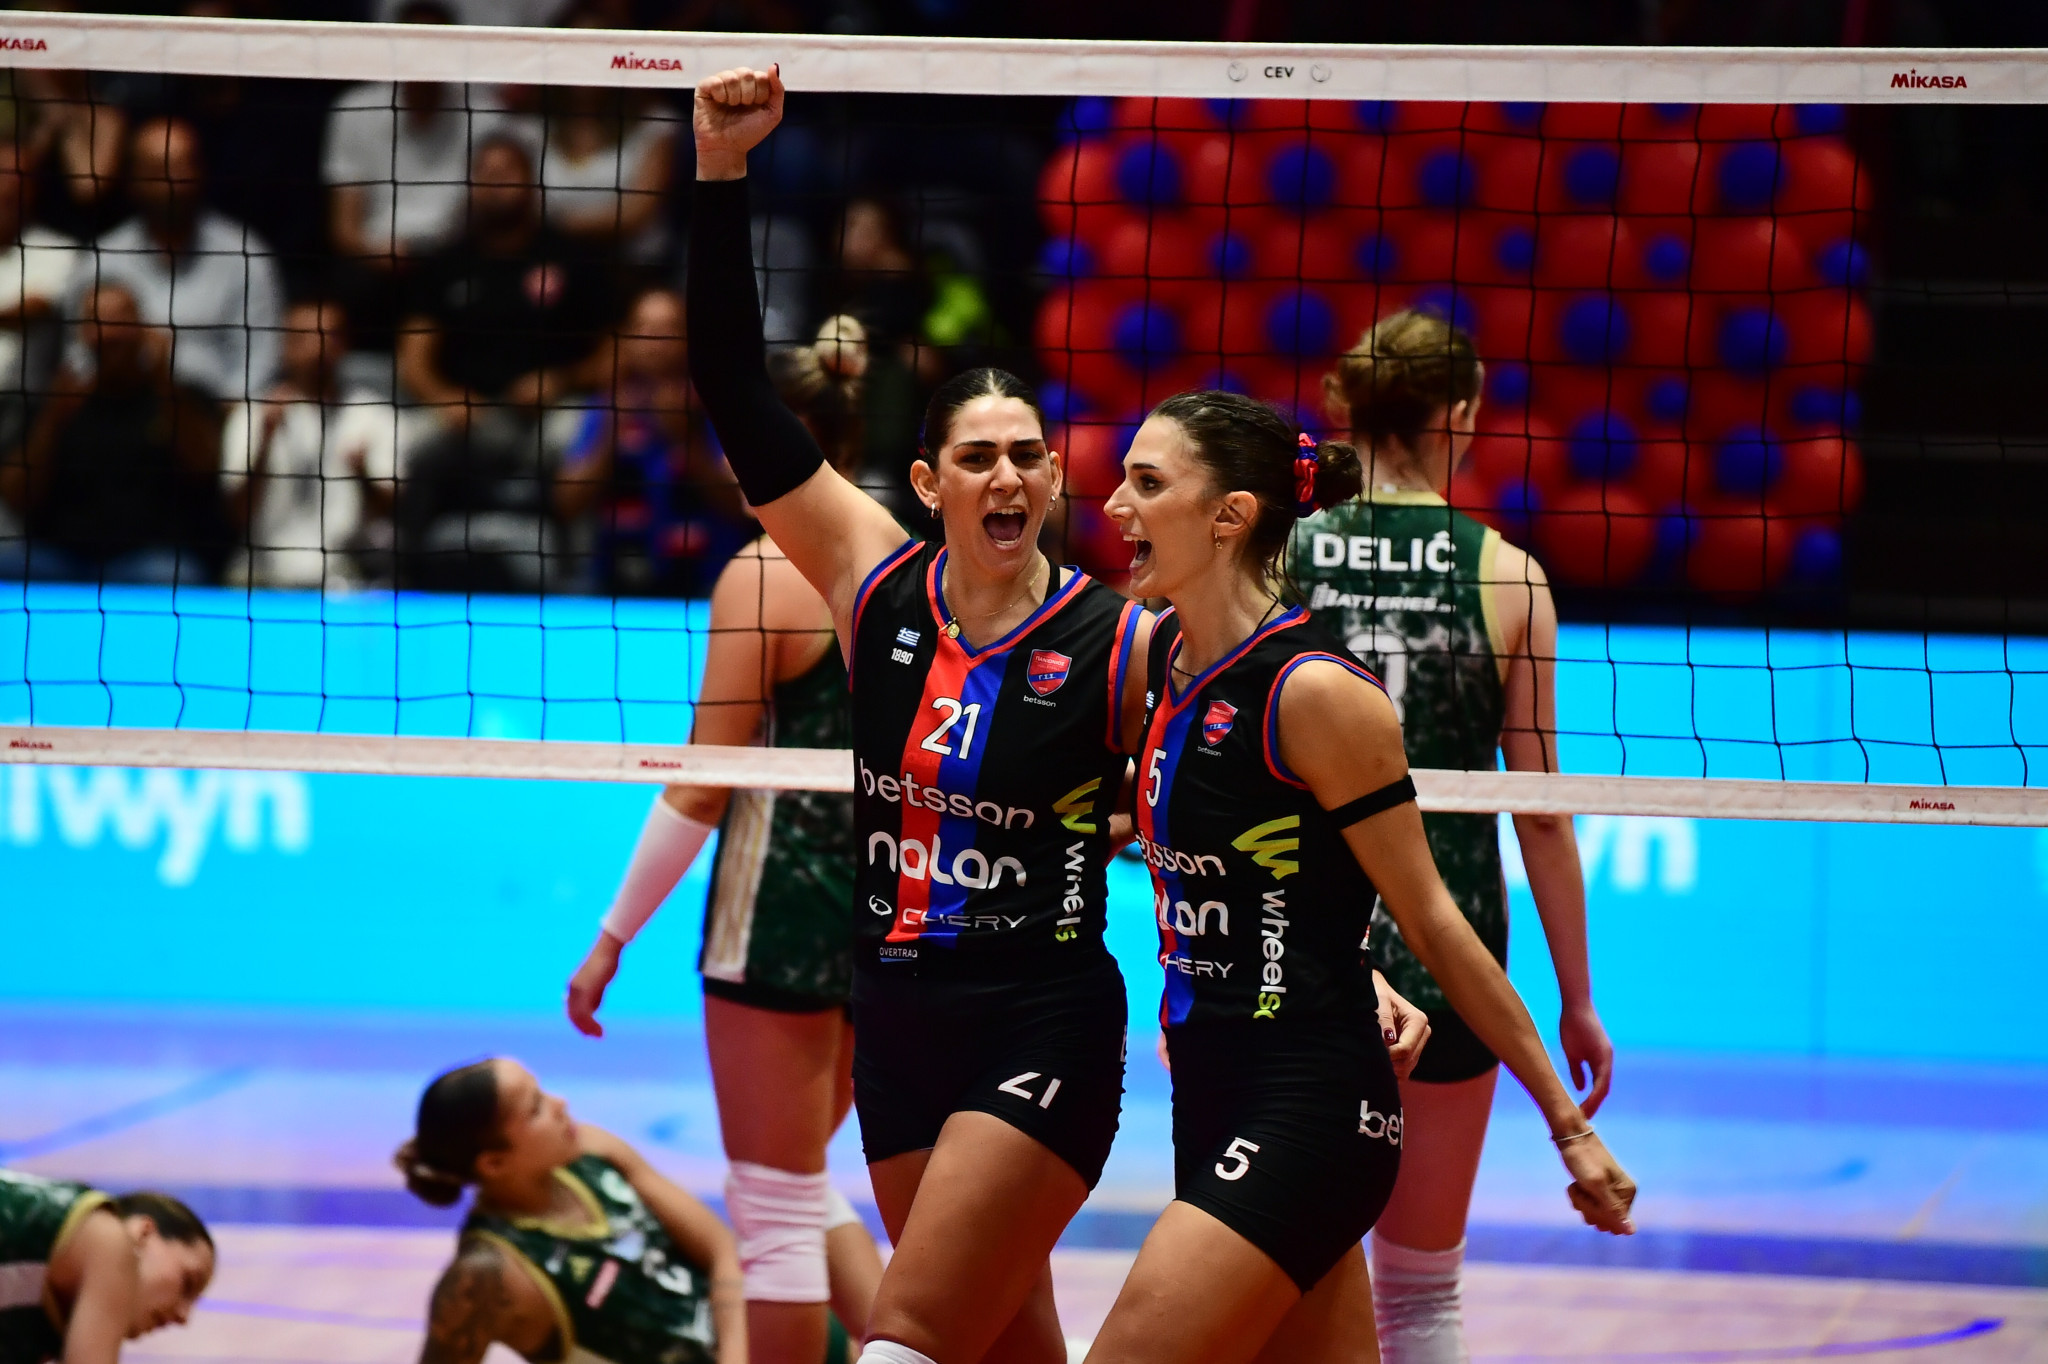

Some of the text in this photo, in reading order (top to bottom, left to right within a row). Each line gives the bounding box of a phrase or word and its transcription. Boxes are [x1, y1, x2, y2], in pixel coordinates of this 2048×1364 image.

[1264, 66, 1295, 78] CEV
[891, 647, 914, 665] 1890
[1023, 695, 1057, 707] betsson
[920, 697, 982, 760] 21
[860, 757, 1035, 829] betsson
[1146, 748, 1167, 807] 5
[902, 907, 1028, 931] CHERY
[1214, 1137, 1261, 1181] 5
